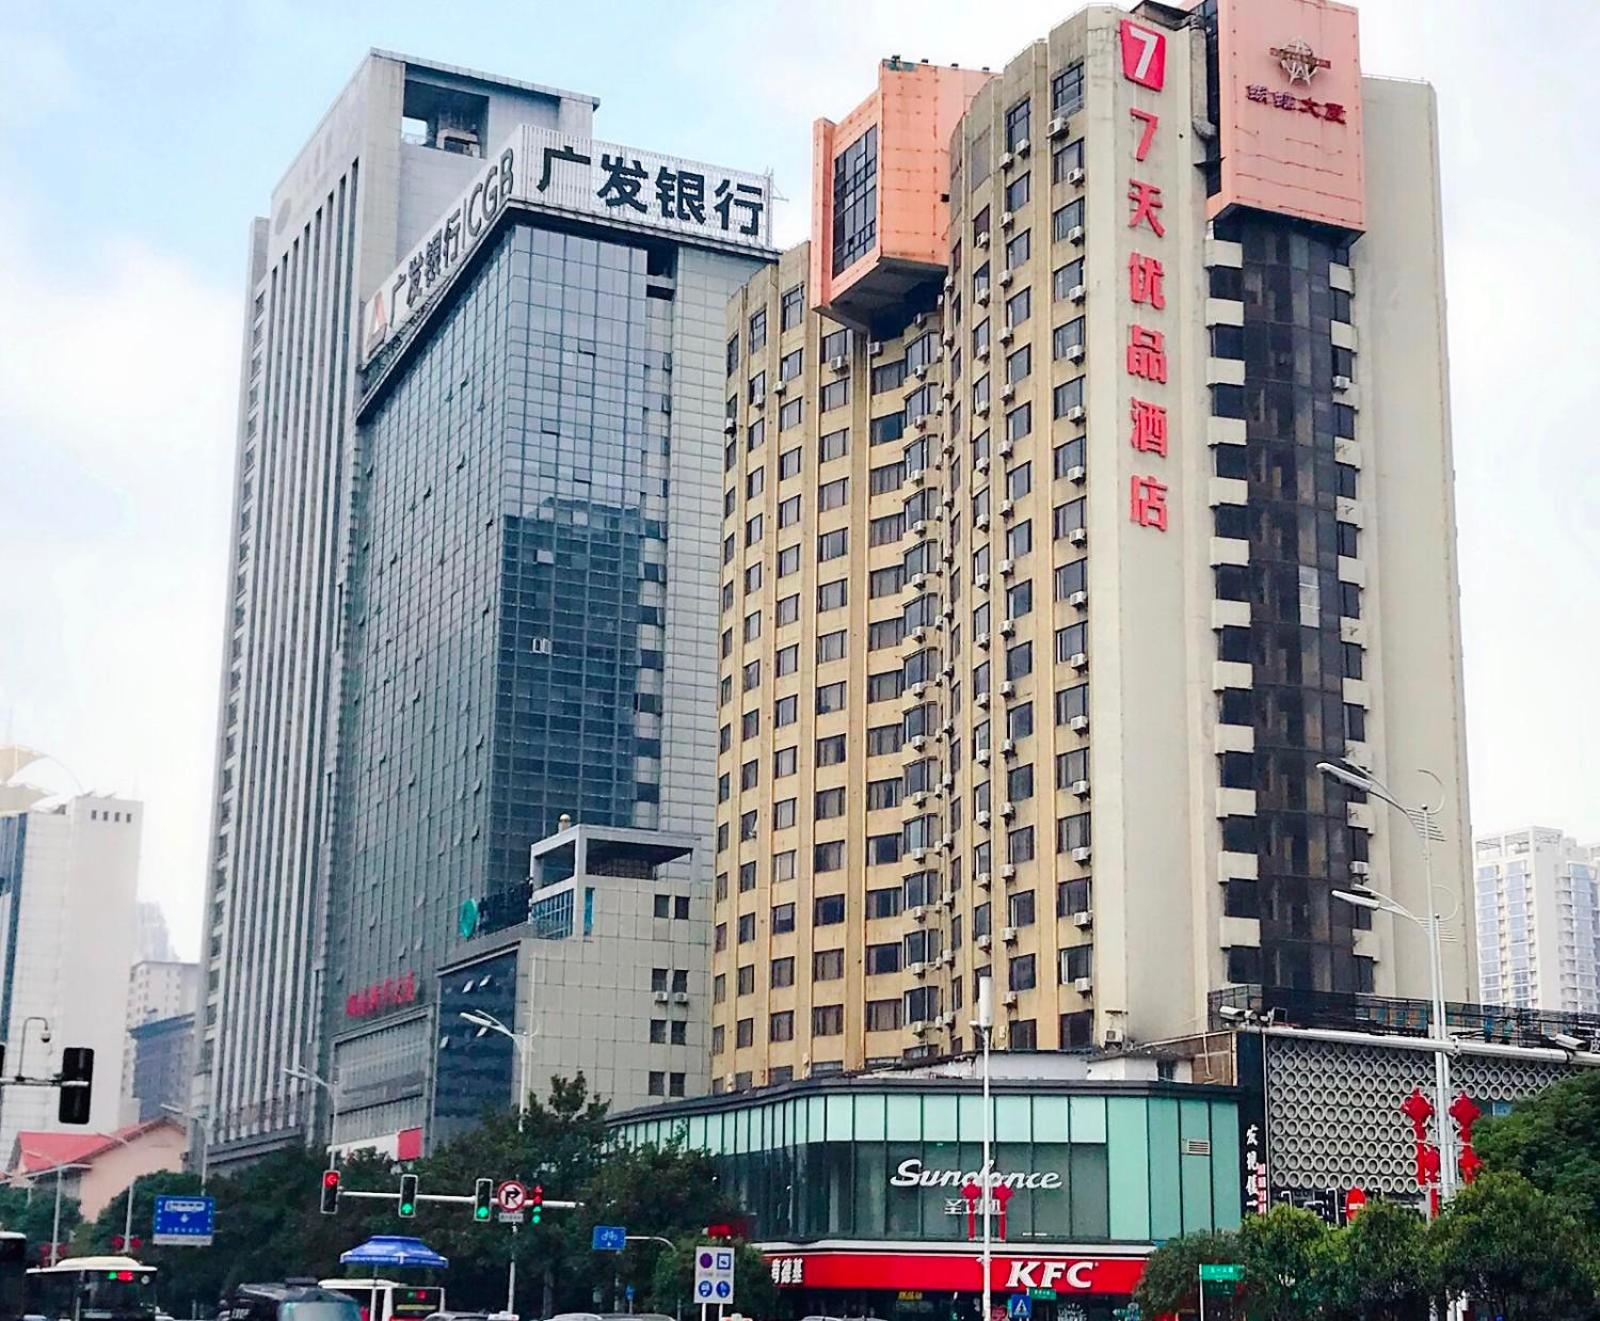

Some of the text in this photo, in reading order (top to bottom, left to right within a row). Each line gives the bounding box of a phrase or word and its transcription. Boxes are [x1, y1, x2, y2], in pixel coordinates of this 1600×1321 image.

[1130, 25, 1158, 80] 7
[467, 147, 514, 237] CGB
[537, 144, 764, 236] 广发银行
[1127, 107, 1168, 532] 7天优品酒店
[1005, 1260, 1094, 1289] KFC
